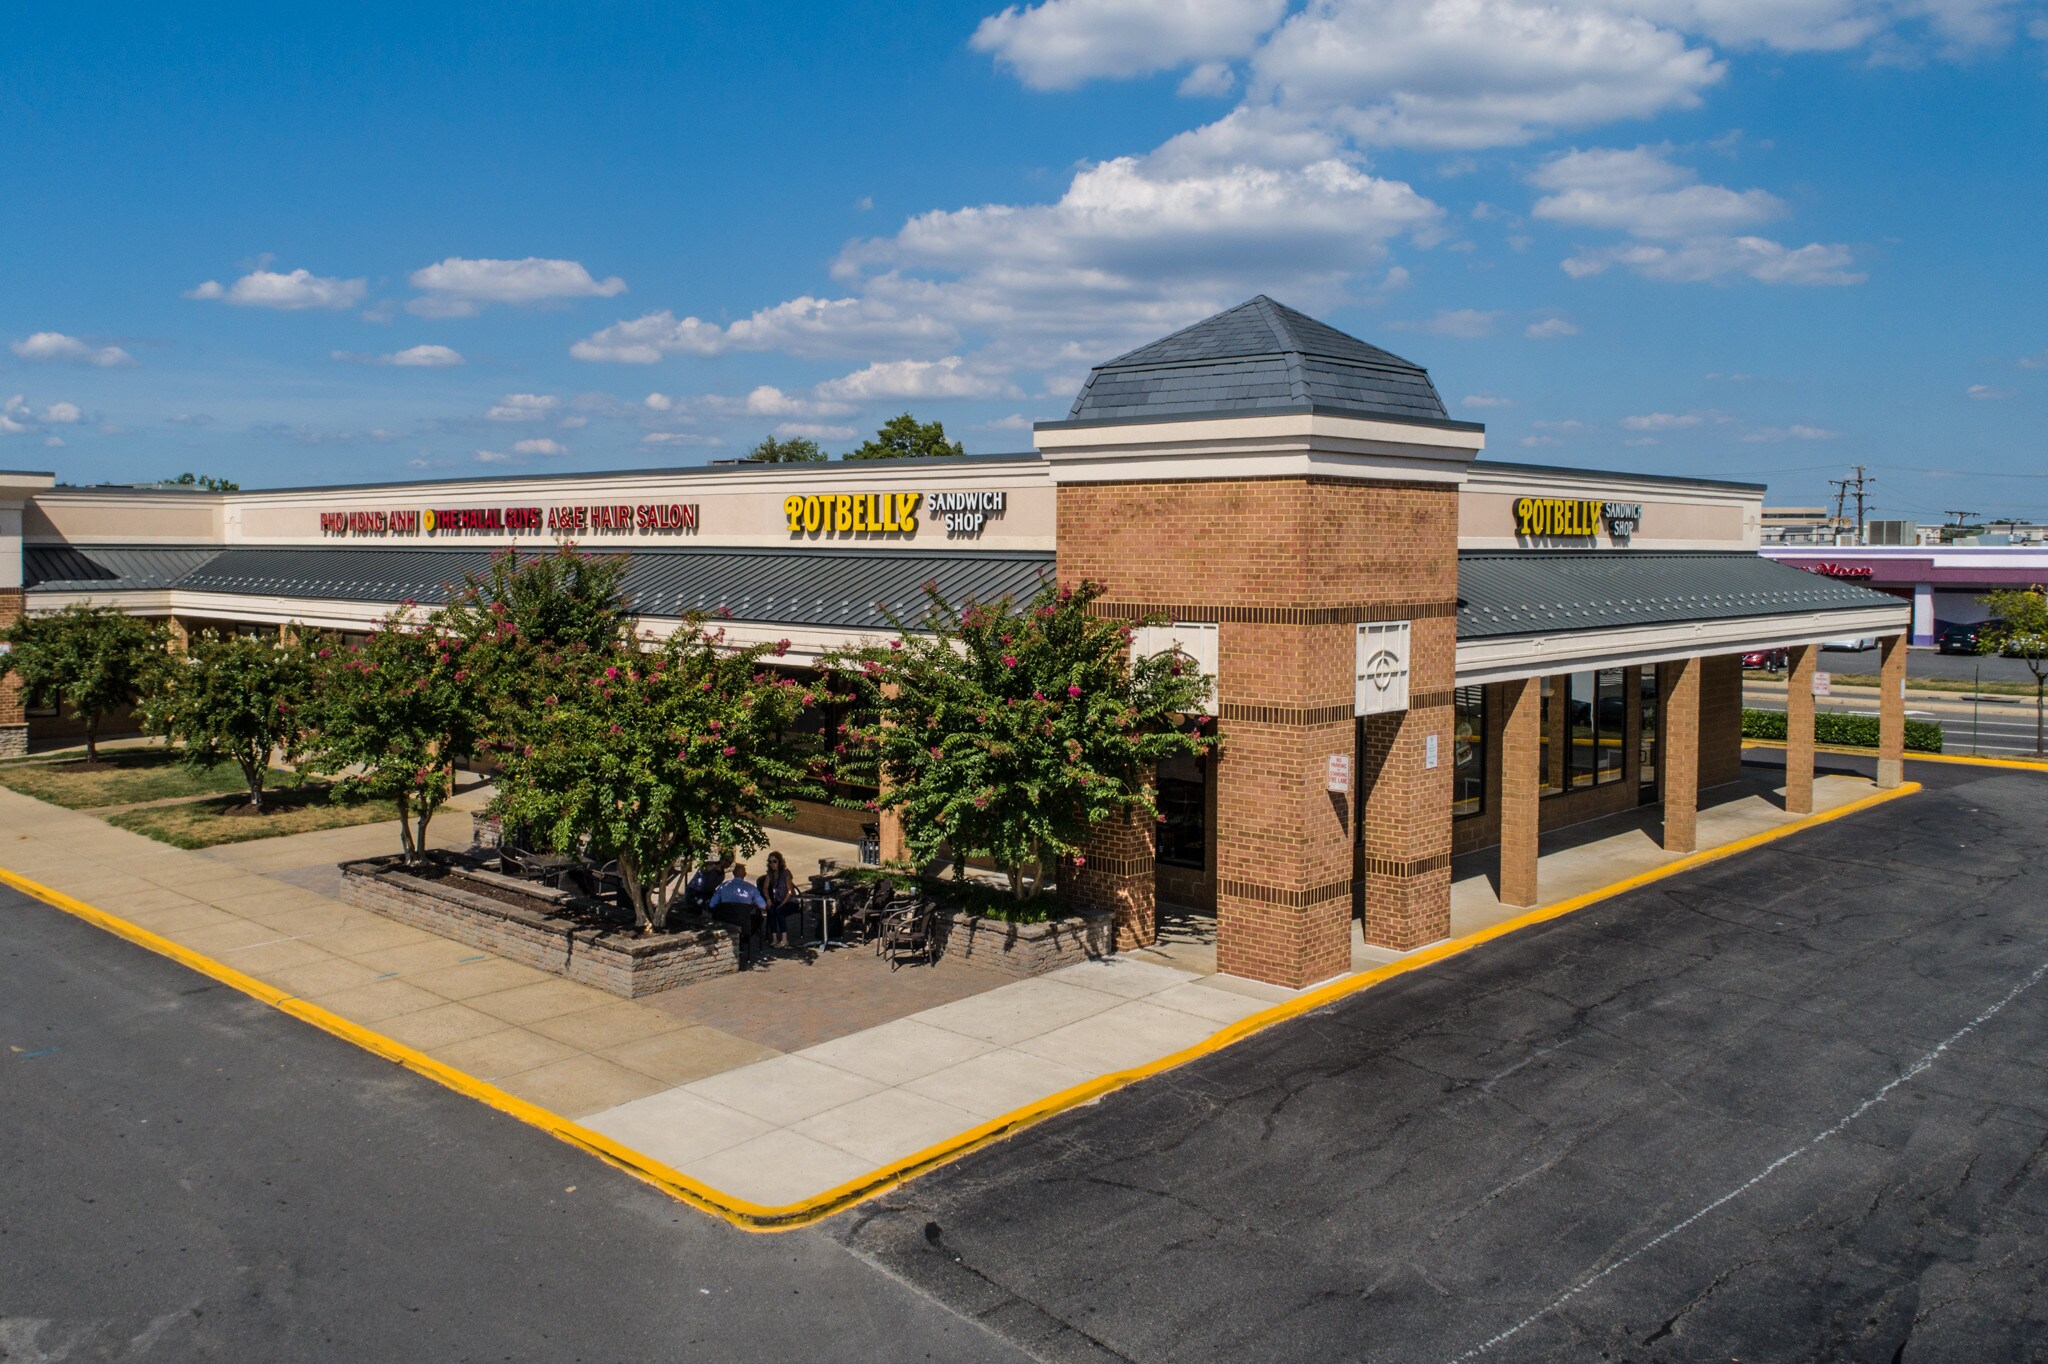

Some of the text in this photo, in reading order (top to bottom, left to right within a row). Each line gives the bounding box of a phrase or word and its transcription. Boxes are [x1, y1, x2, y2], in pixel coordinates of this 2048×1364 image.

[927, 492, 1003, 511] SANDWICH
[1605, 503, 1642, 519] SANDWICH
[320, 510, 416, 532] PHO HONG ANH
[435, 506, 540, 529] THE HALAL GUYS
[547, 503, 697, 529] A&E HAIR SALON
[783, 492, 920, 532] POTBELLY
[1518, 497, 1603, 535] POTBELLY
[945, 513, 984, 532] SHOP
[1614, 521, 1634, 536] SHOP
[1816, 563, 1873, 576] Moon
